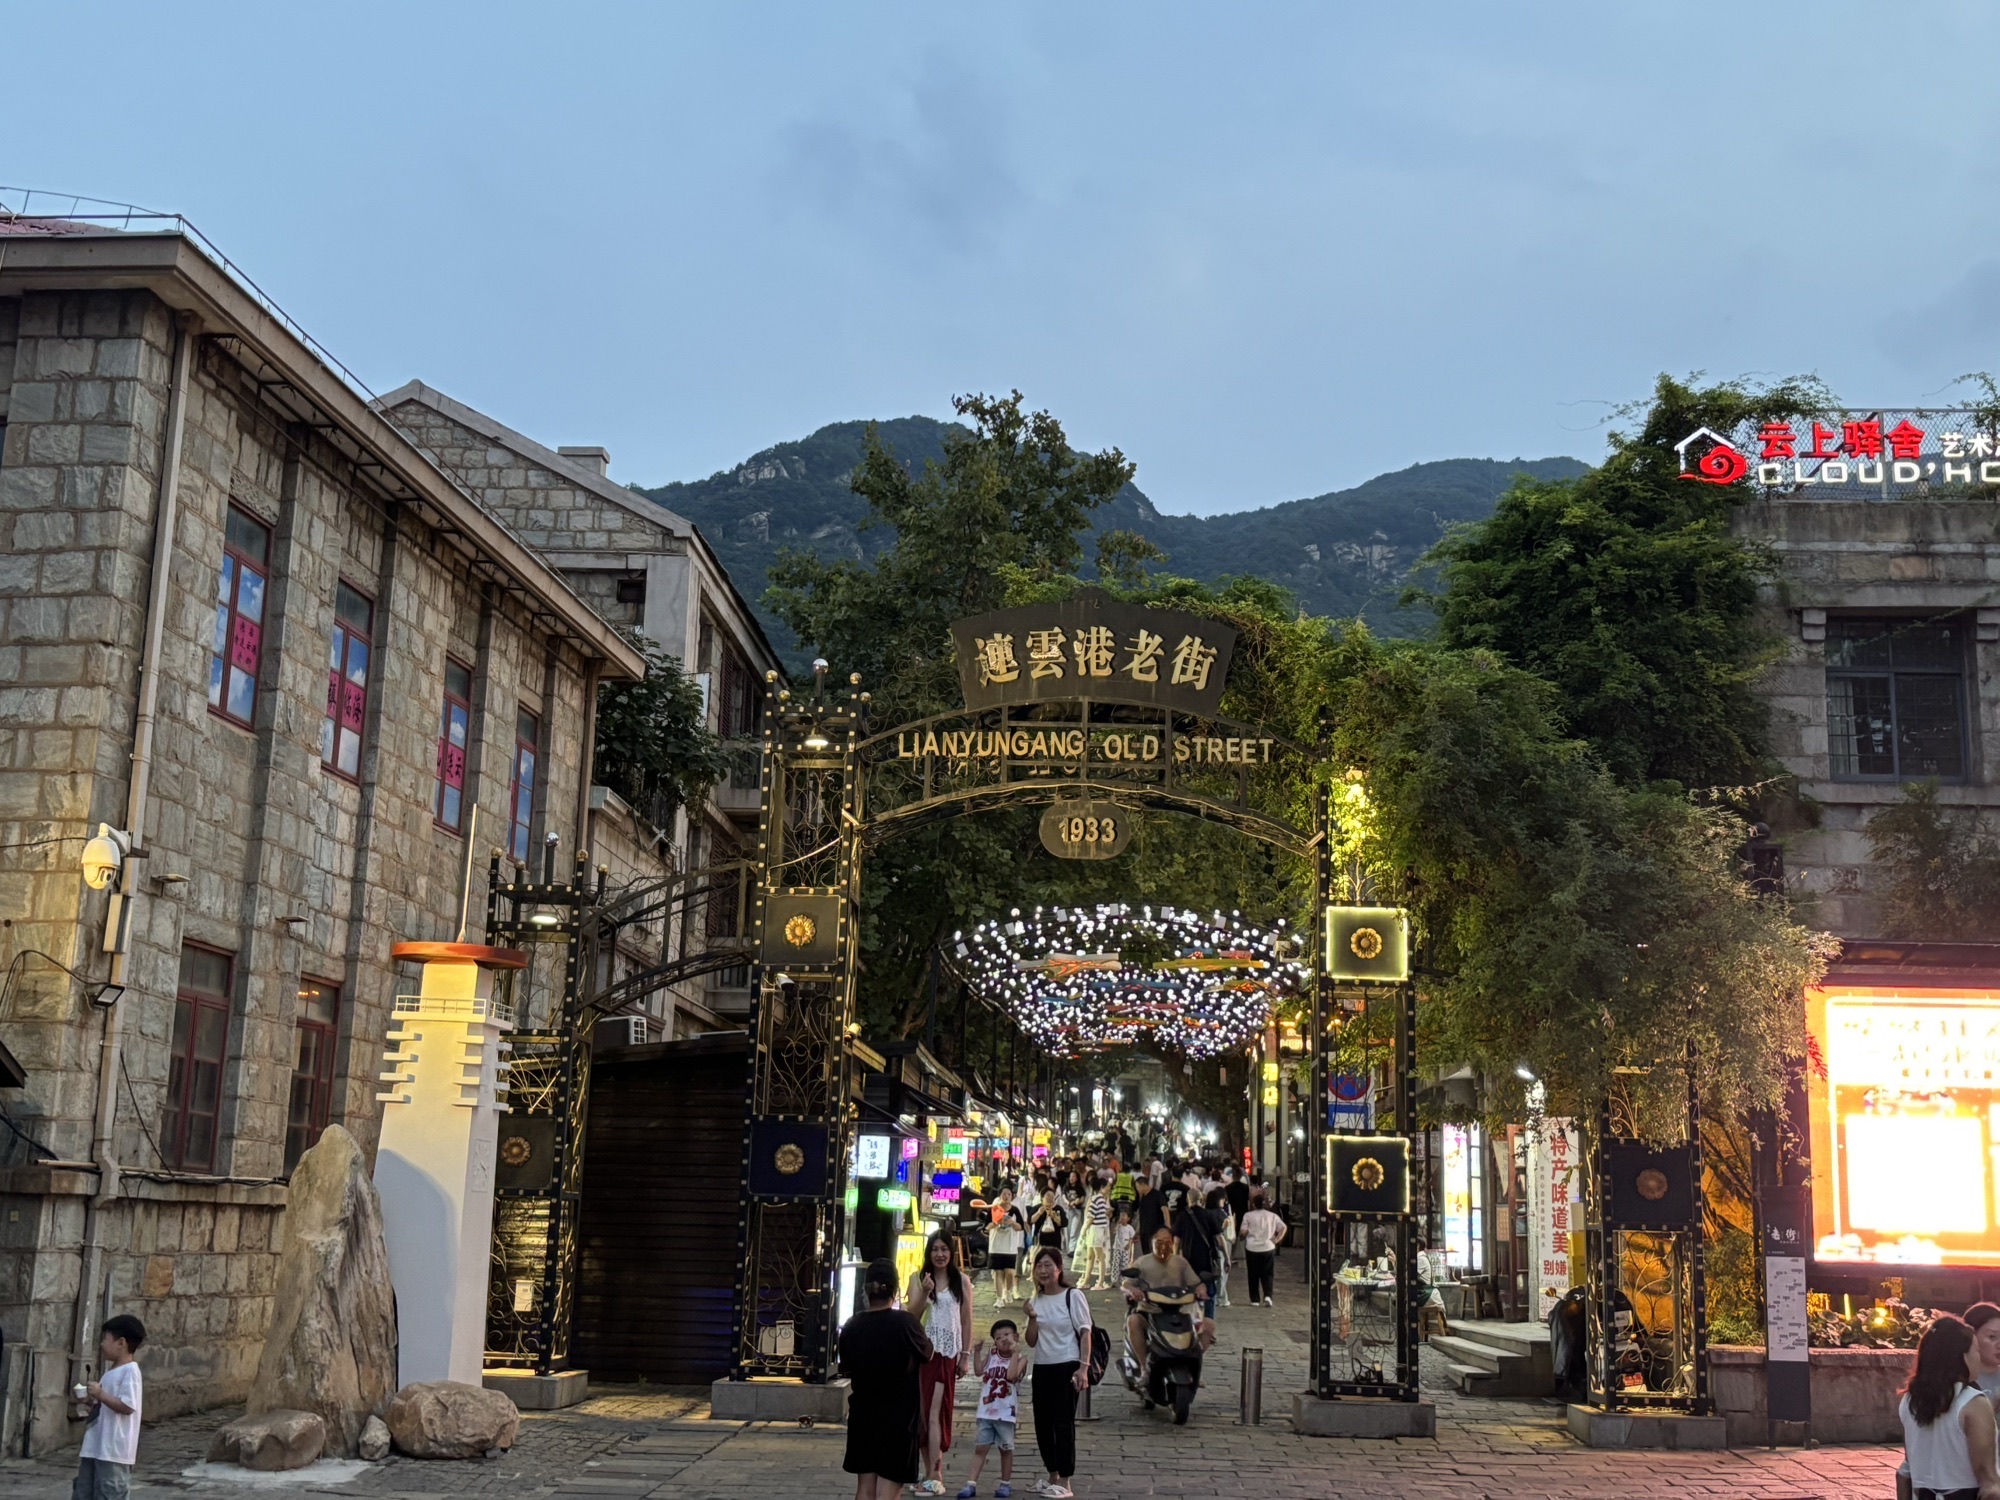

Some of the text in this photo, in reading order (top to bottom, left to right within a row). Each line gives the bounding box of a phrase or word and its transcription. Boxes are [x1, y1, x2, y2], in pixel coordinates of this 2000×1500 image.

[1757, 419, 2000, 459] 云上驿舍 艺术
[974, 625, 1218, 691] 連雲港老街
[898, 729, 1275, 764] LIANYUNGANG OLD STREET
[1058, 816, 1117, 843] 1933
[1550, 1132, 1570, 1254] 特产味道美
[1543, 1259, 1568, 1277] 别嫌
[989, 1379, 1009, 1399] 23
